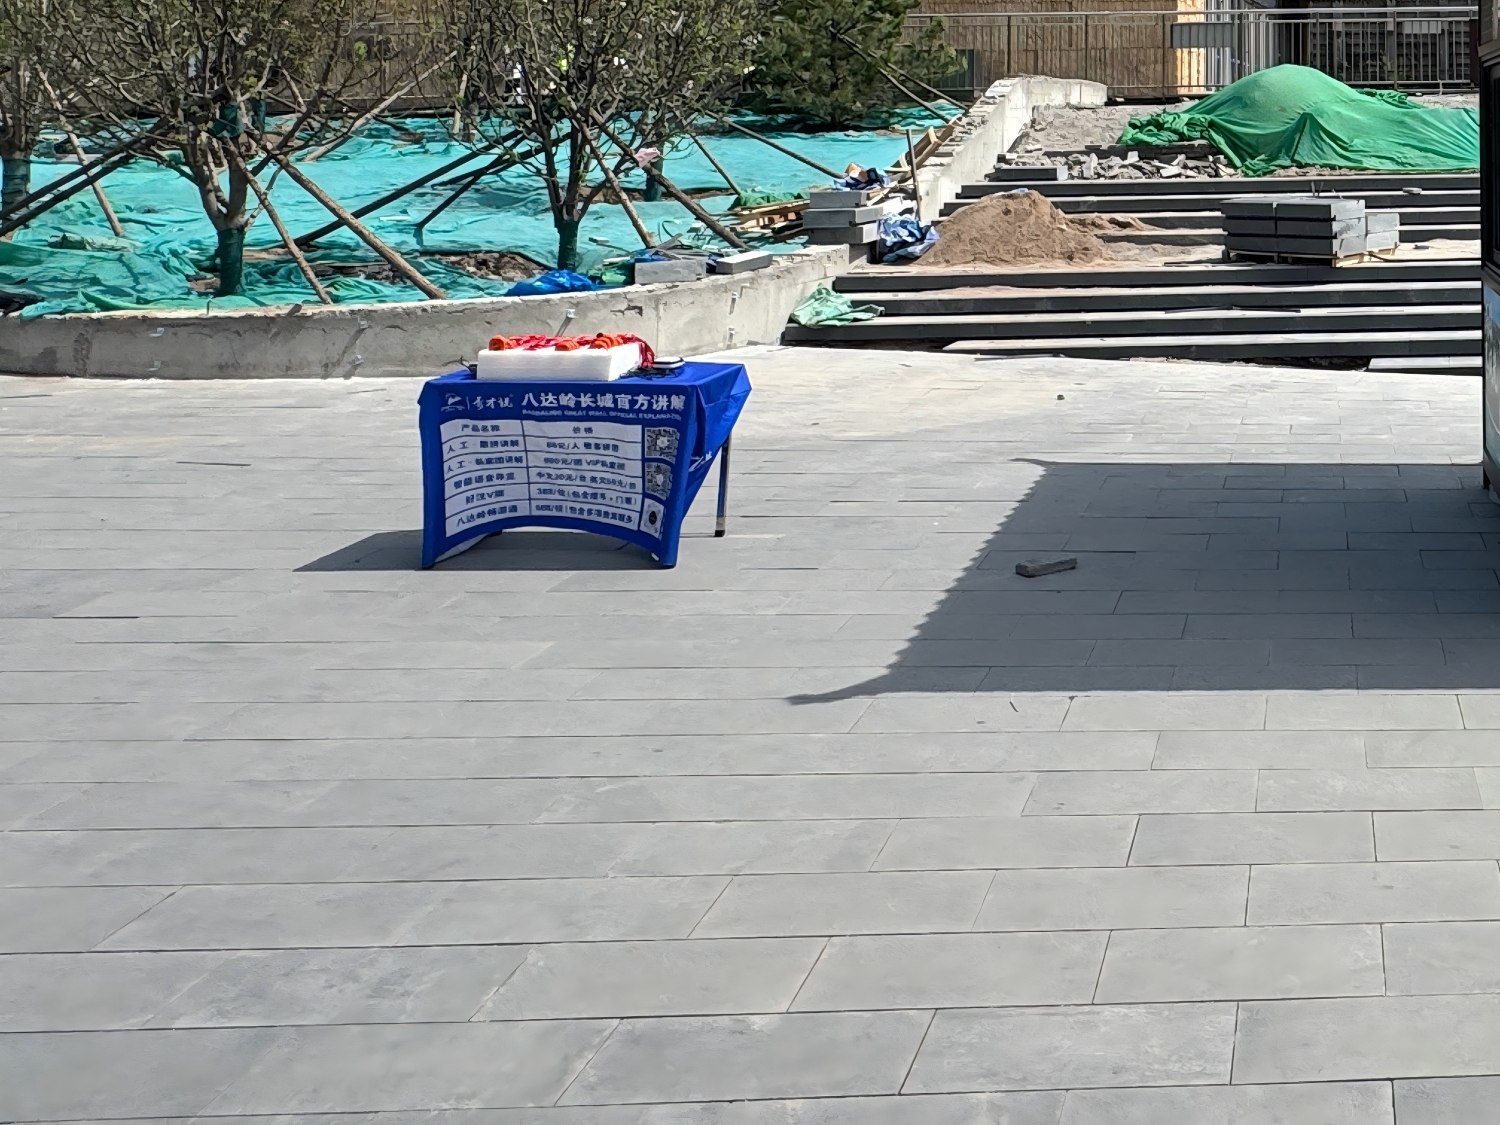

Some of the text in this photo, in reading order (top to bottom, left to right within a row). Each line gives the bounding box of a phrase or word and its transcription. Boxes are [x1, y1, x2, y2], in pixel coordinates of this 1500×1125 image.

[521, 392, 686, 411] 八达岭长城官方讲解
